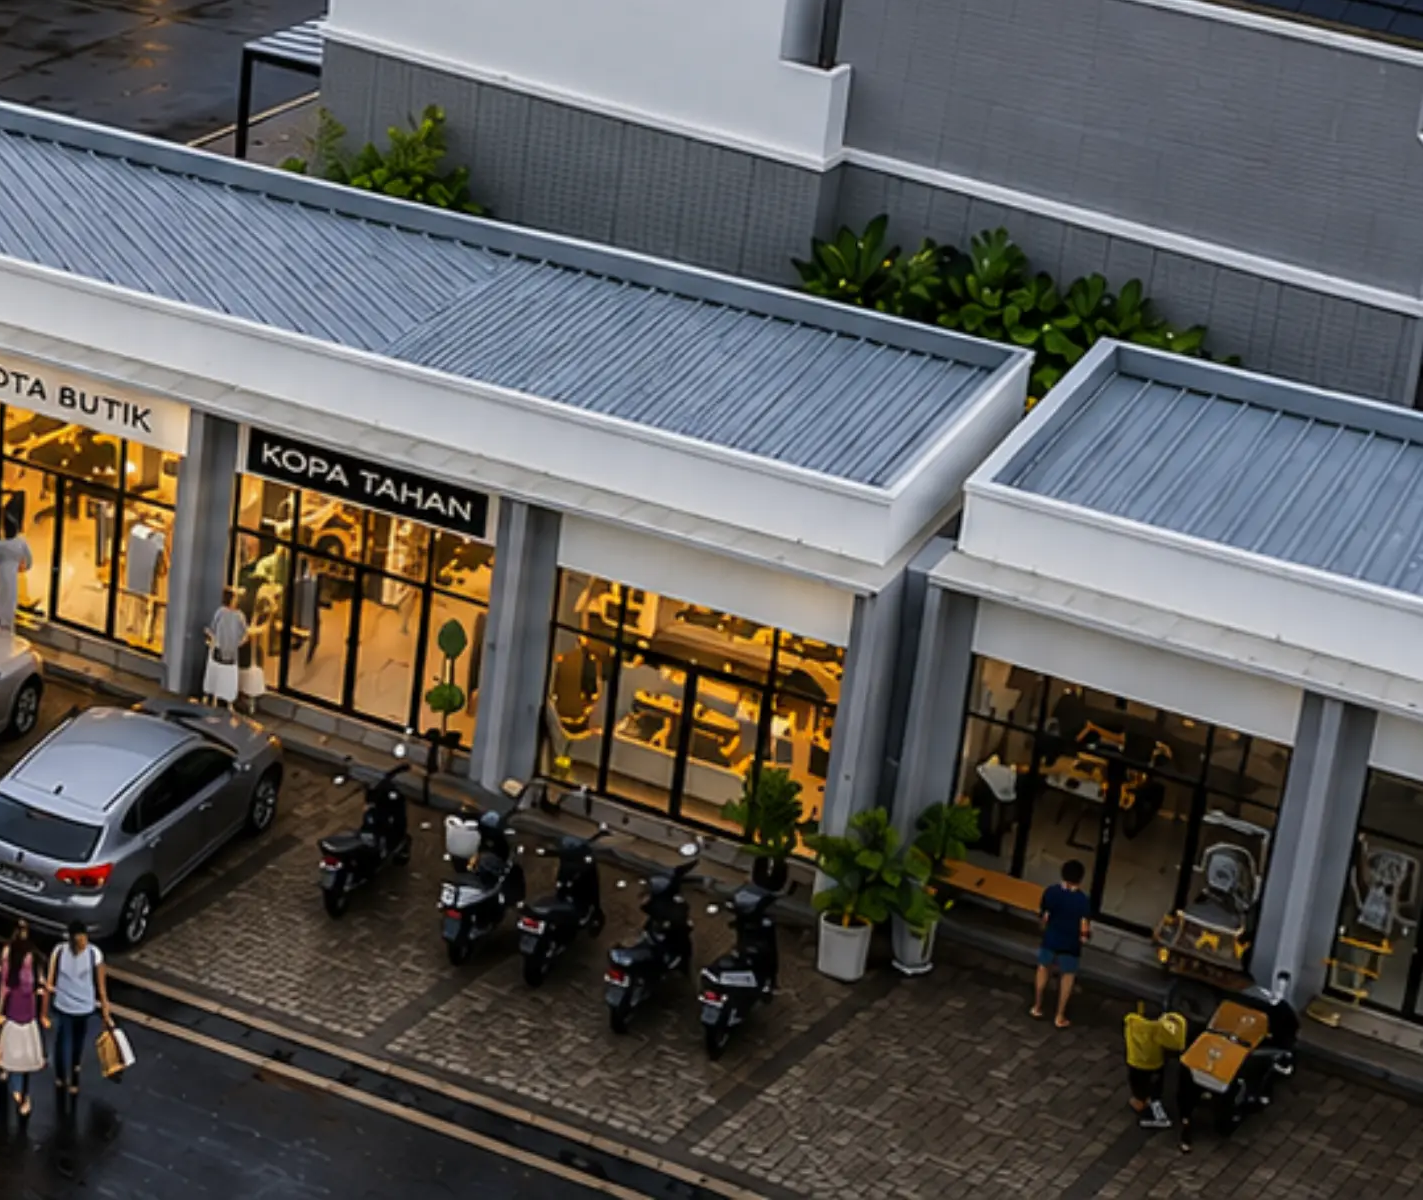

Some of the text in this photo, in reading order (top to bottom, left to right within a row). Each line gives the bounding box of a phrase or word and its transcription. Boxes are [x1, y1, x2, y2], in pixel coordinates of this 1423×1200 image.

[58, 387, 152, 433] BUTIK
[262, 443, 471, 521] KOPA TAHAN
